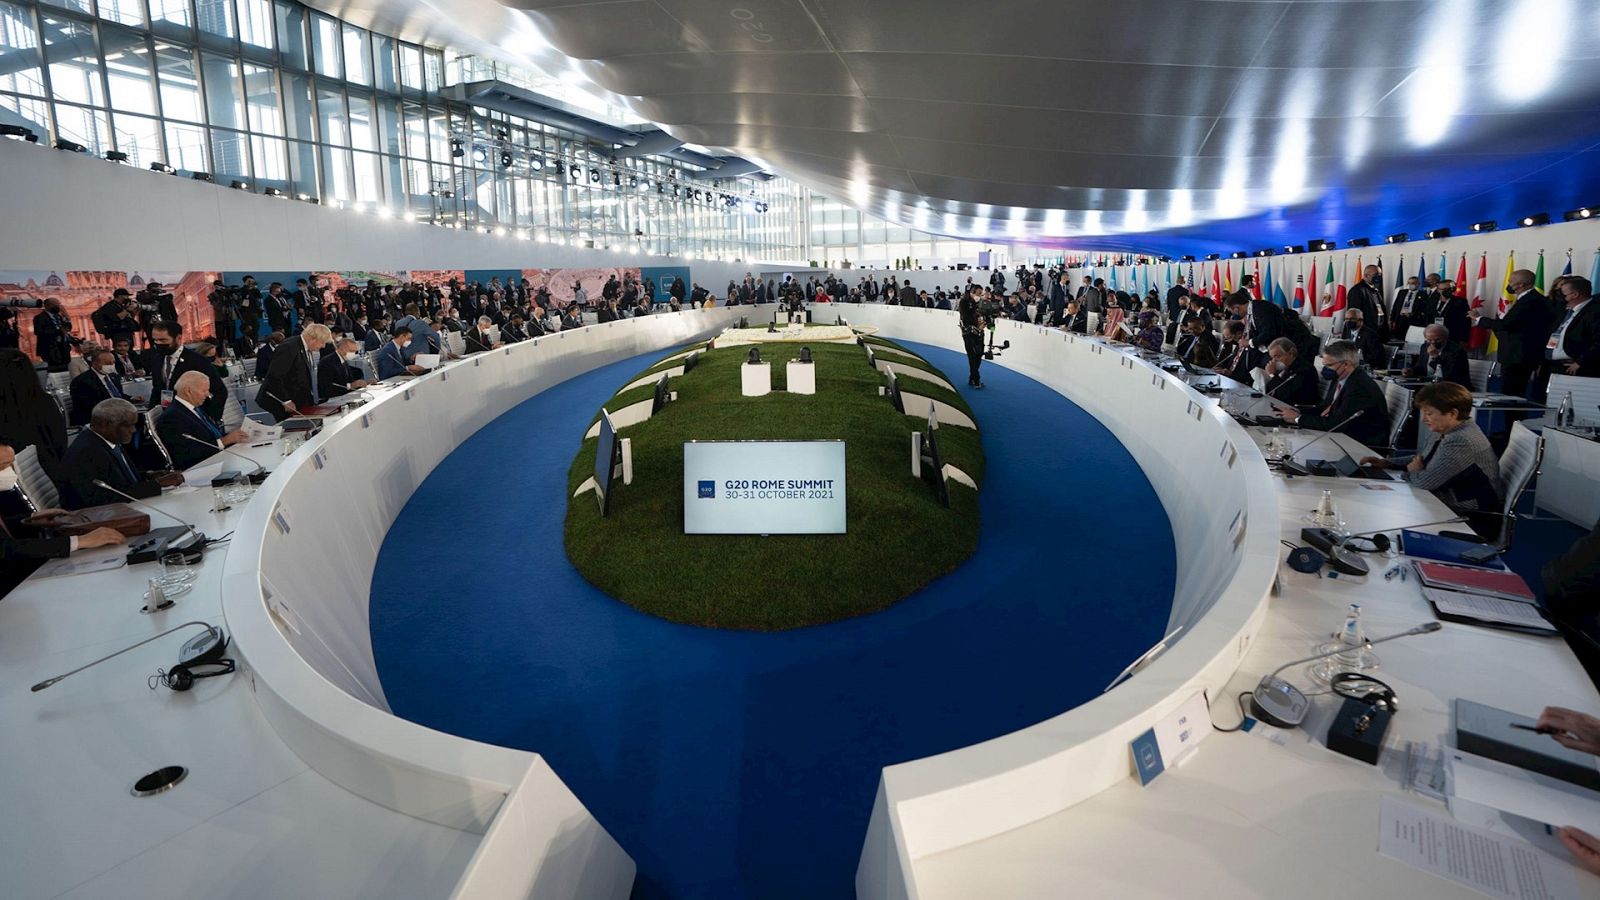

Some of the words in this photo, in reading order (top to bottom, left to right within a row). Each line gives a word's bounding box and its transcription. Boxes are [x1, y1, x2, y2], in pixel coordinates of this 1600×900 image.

[725, 480, 749, 490] G20
[752, 480, 785, 490] ROME
[788, 480, 834, 490] SUMMIT
[725, 490, 755, 499] 30-31
[758, 490, 806, 499] OCTOBER
[808, 490, 834, 499] 2021
